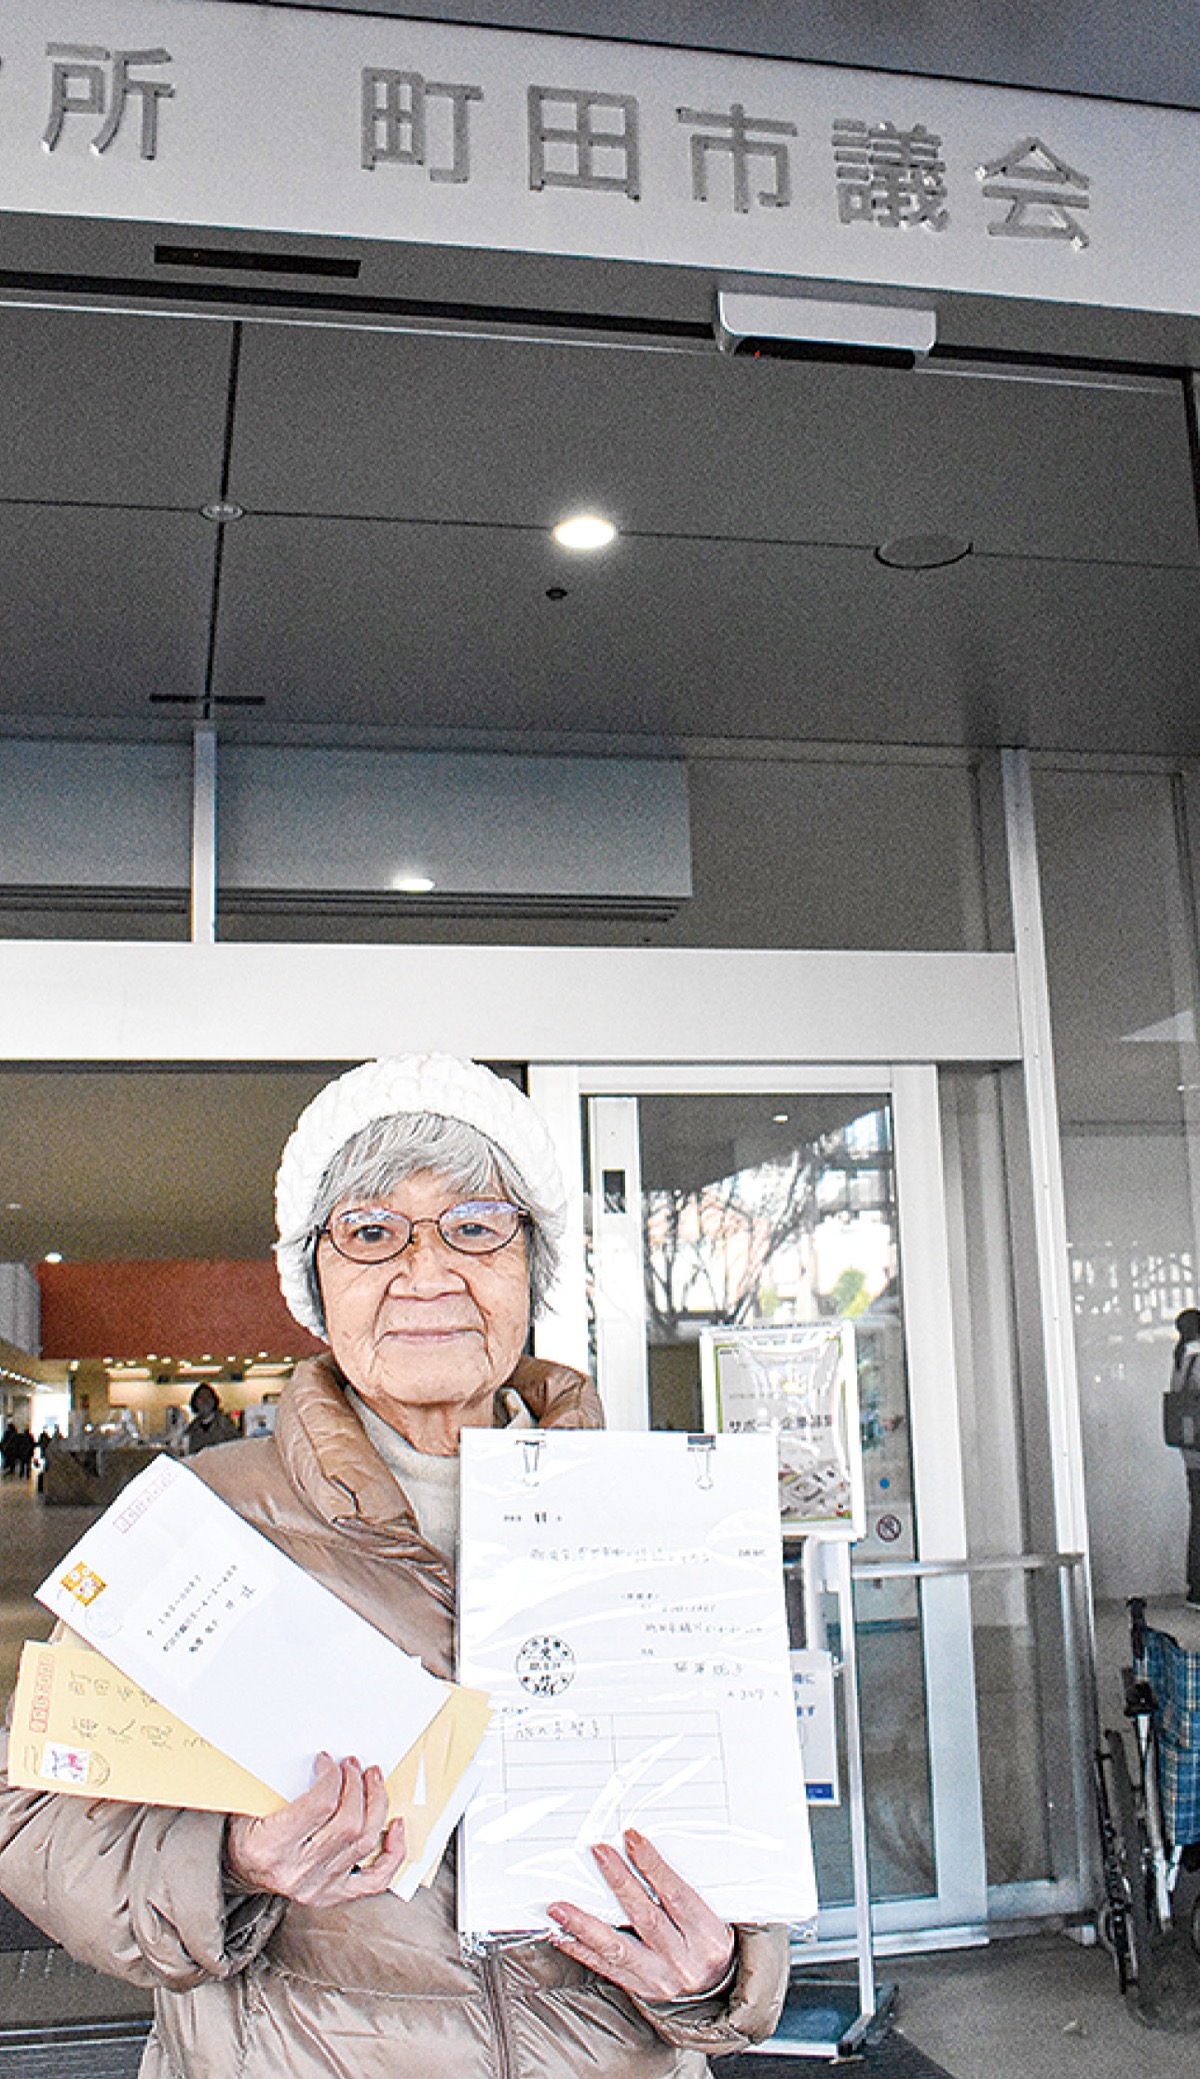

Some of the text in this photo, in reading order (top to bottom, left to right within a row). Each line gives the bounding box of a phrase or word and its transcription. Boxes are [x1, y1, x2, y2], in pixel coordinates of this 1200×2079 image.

[41, 42, 1090, 251] 所 町田市議会
